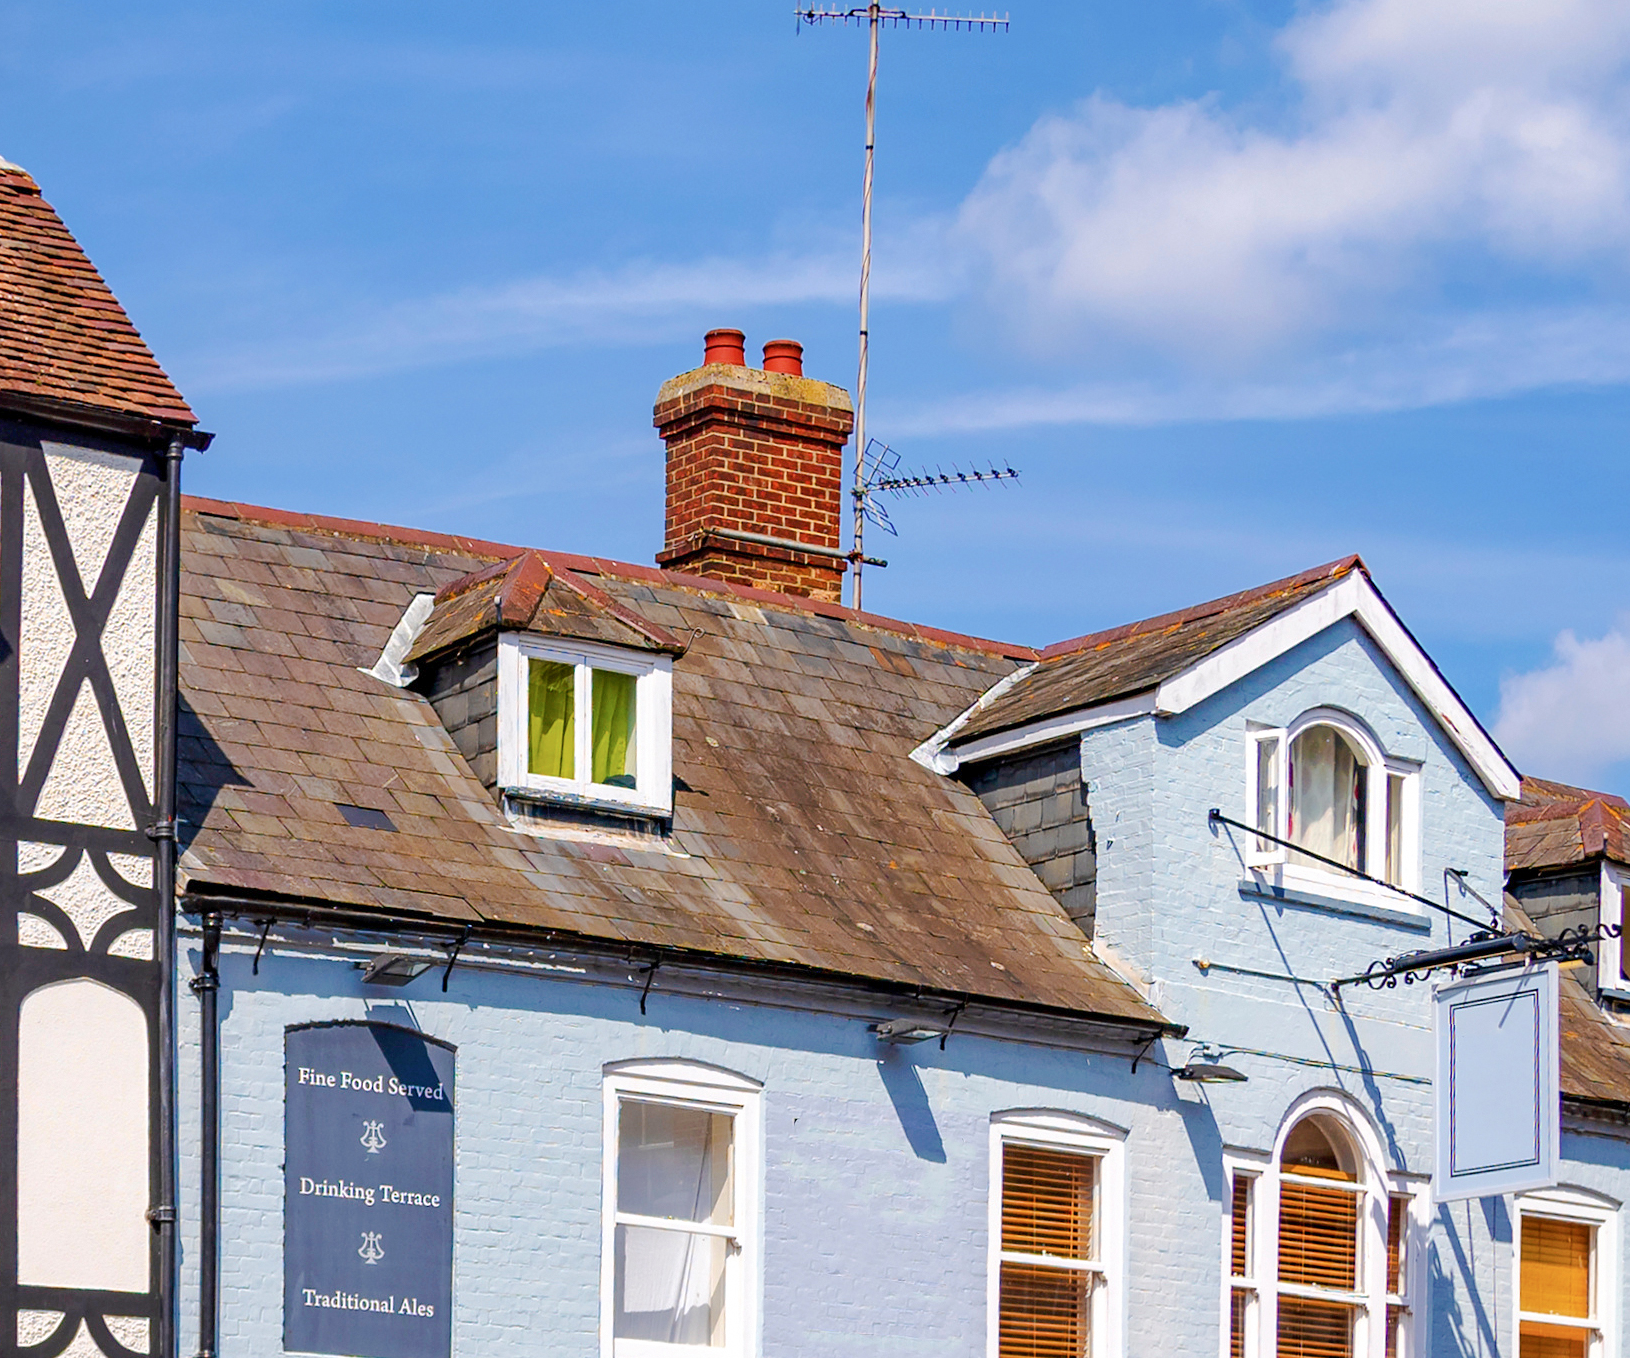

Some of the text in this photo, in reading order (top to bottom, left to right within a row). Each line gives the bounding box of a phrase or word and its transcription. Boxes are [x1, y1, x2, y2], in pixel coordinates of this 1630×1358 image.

[298, 1067, 444, 1100] Fine Food Served
[299, 1177, 441, 1207] Drinking Terrace
[302, 1288, 435, 1318] Traditional Ales
